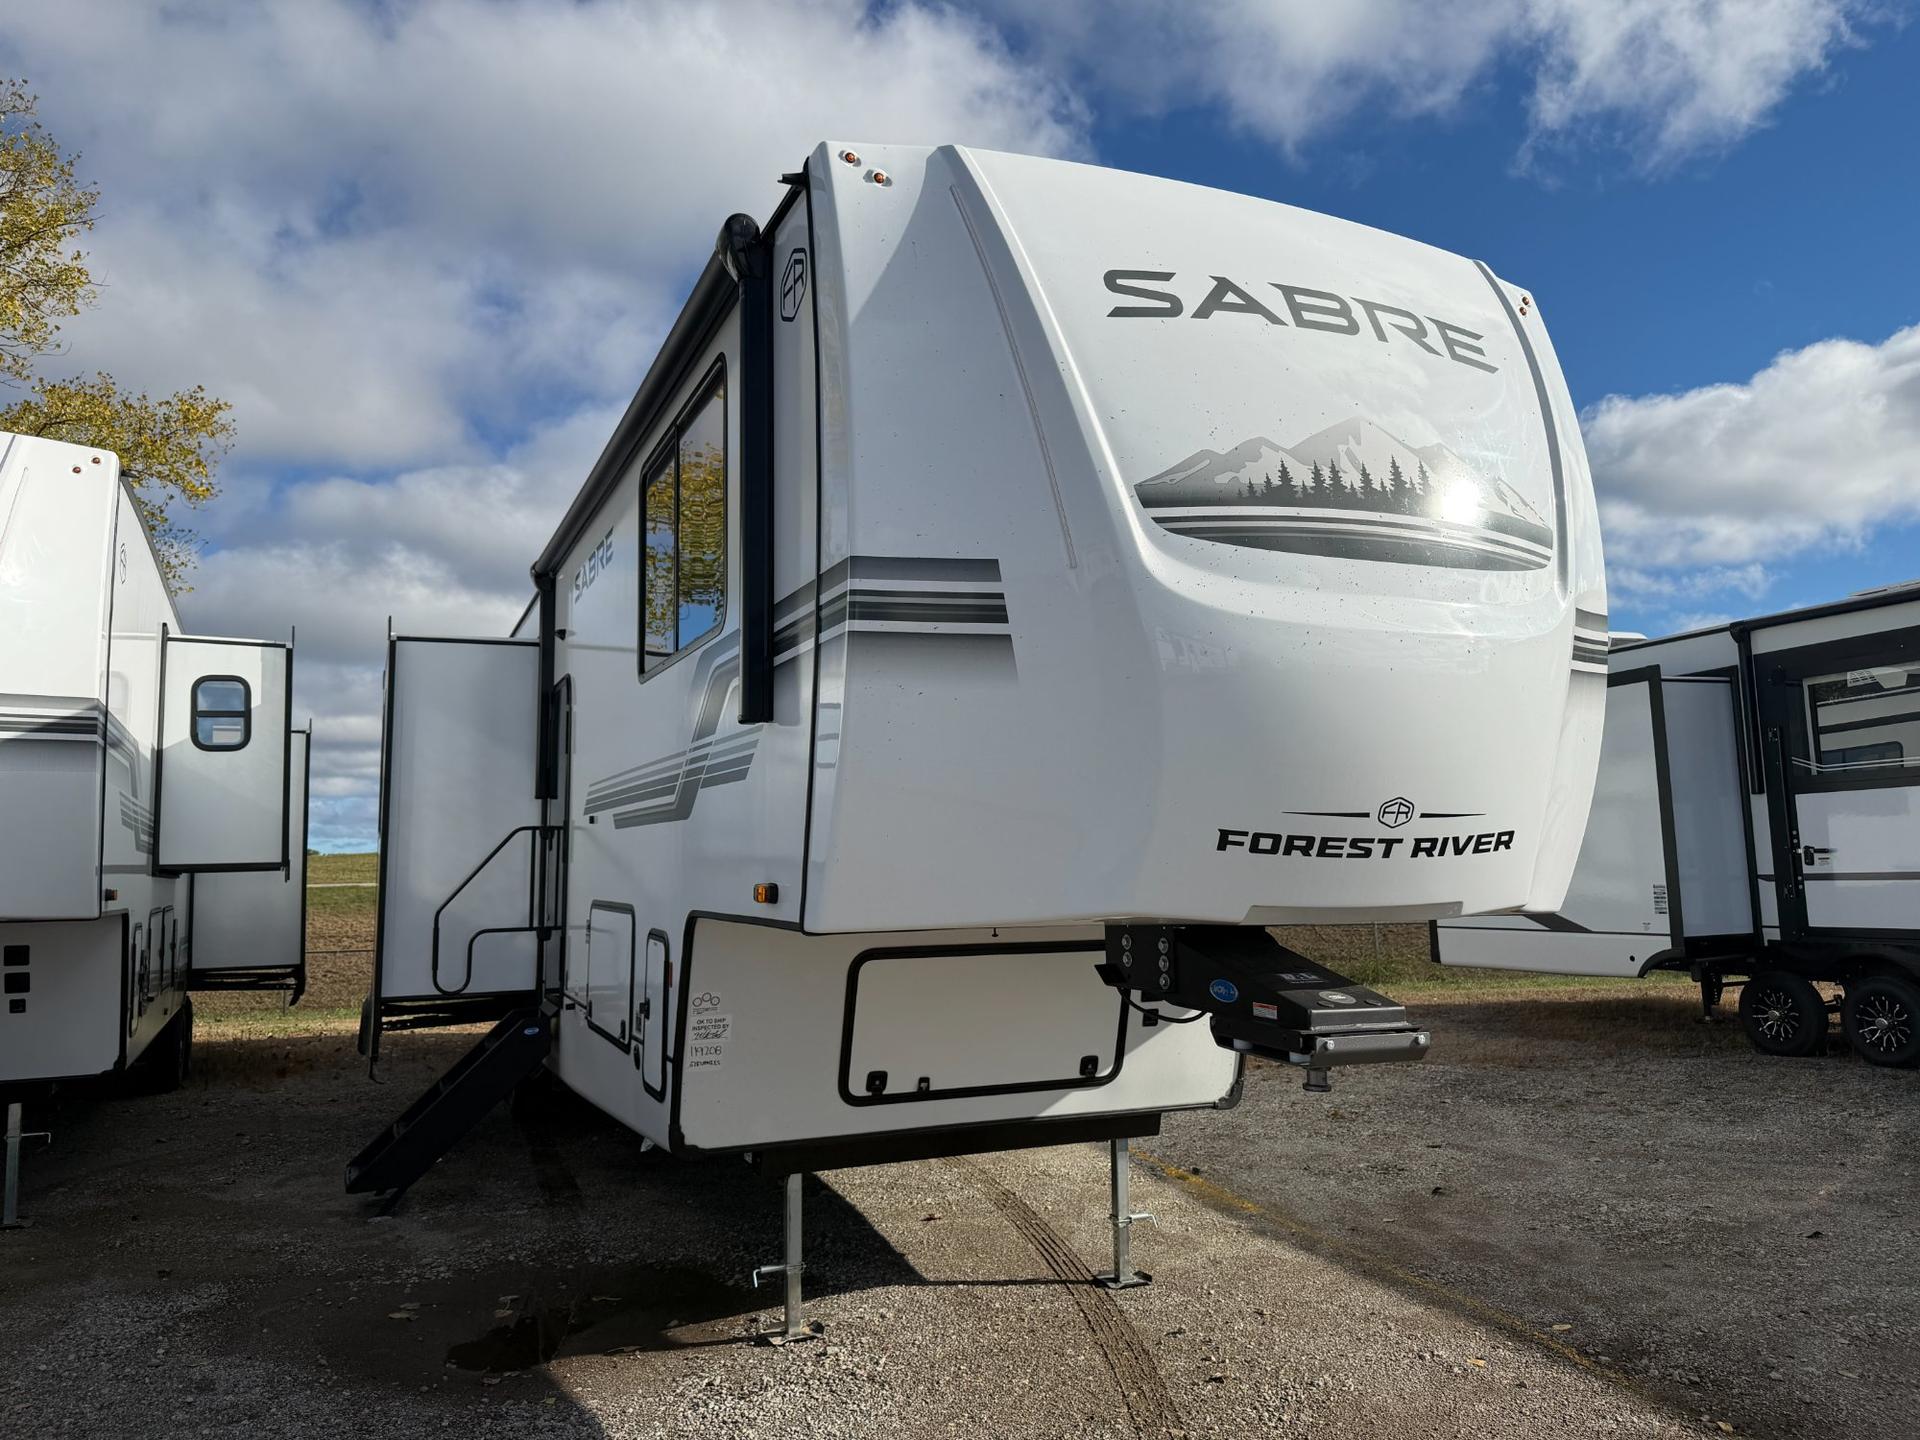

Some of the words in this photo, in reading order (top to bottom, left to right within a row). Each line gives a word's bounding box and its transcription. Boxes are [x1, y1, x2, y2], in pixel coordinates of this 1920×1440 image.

[1103, 269, 1499, 374] SABRE
[574, 526, 614, 605] SABRE
[1216, 829, 1403, 859] FOREST
[1410, 830, 1515, 858] RIVER
